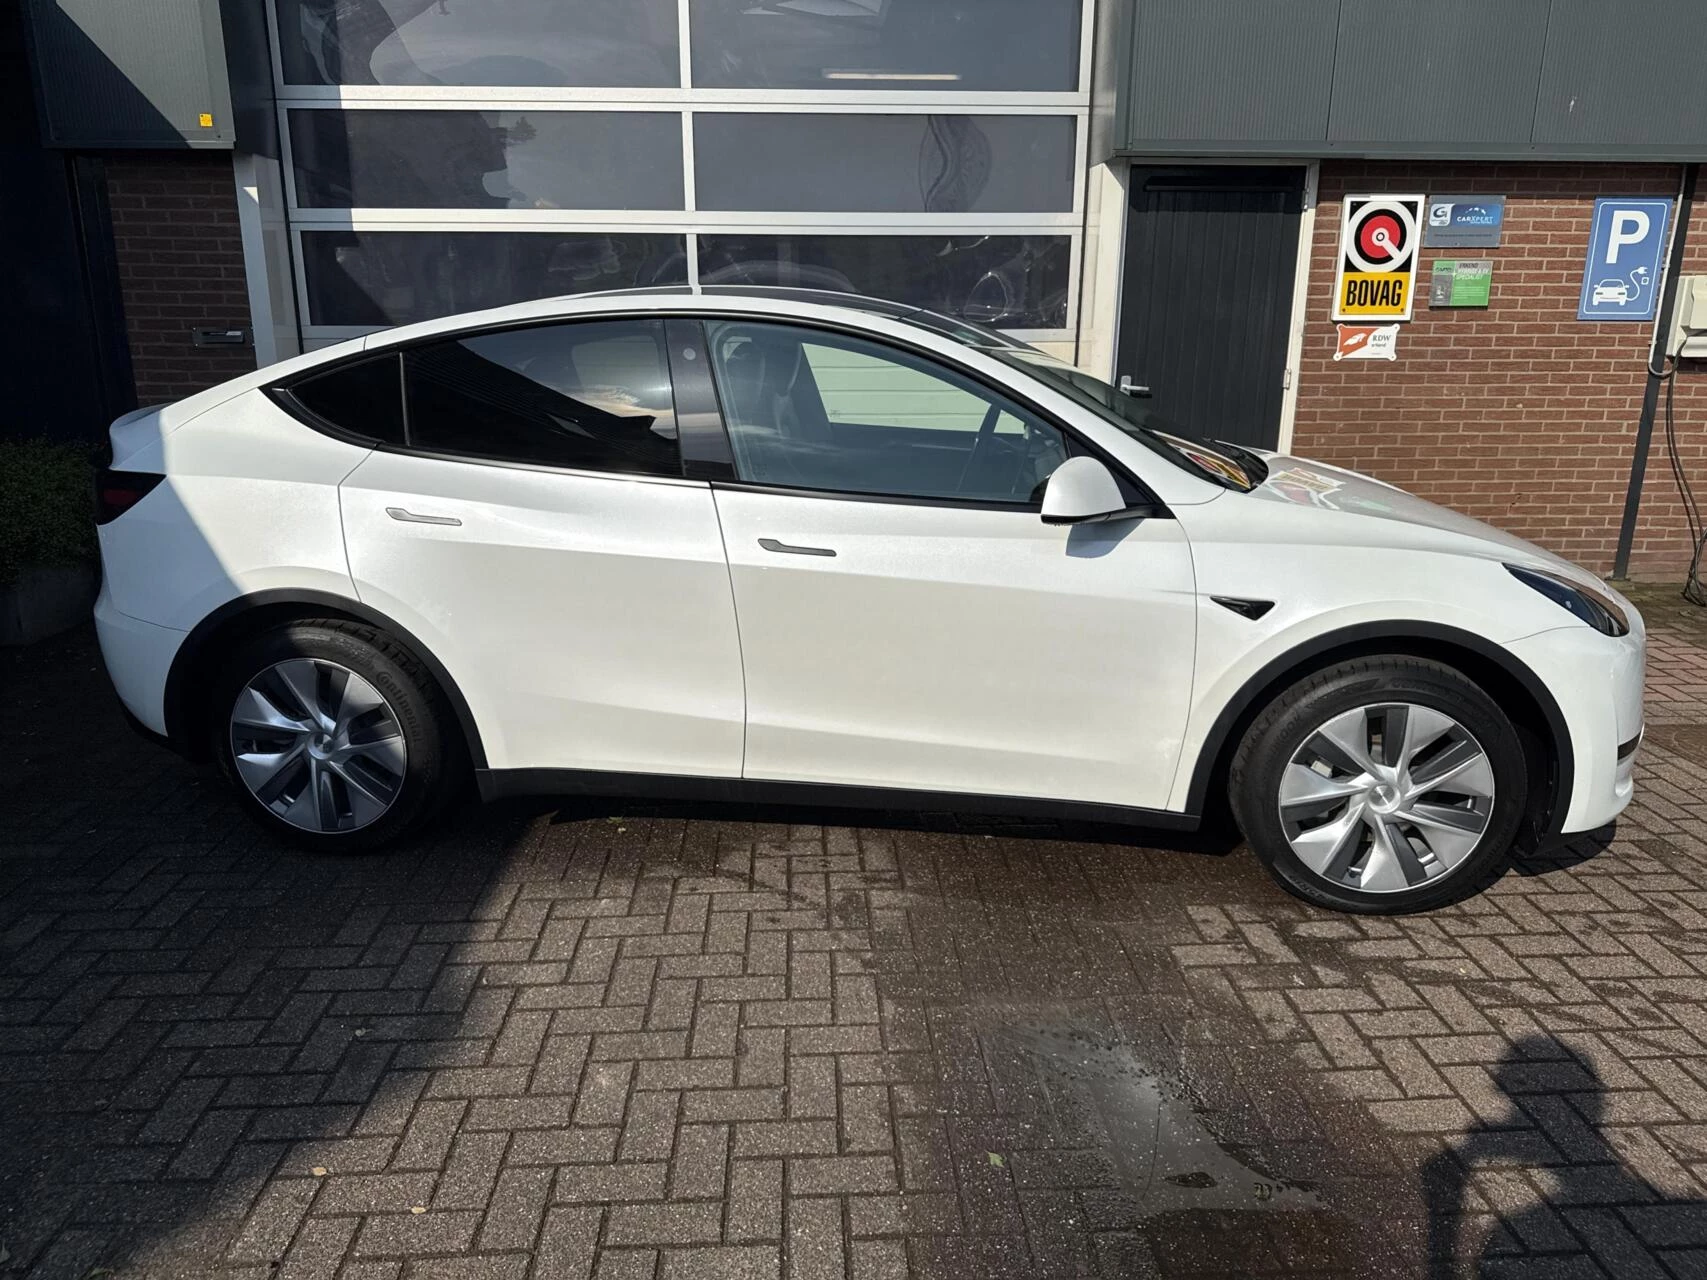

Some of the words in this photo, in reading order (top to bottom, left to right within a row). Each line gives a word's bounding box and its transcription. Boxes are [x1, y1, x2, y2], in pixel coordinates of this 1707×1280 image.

[1605, 210, 1650, 264] P
[1346, 279, 1403, 307] BOVAG
[1372, 334, 1392, 342] RDW
[375, 671, 424, 743] Continental
